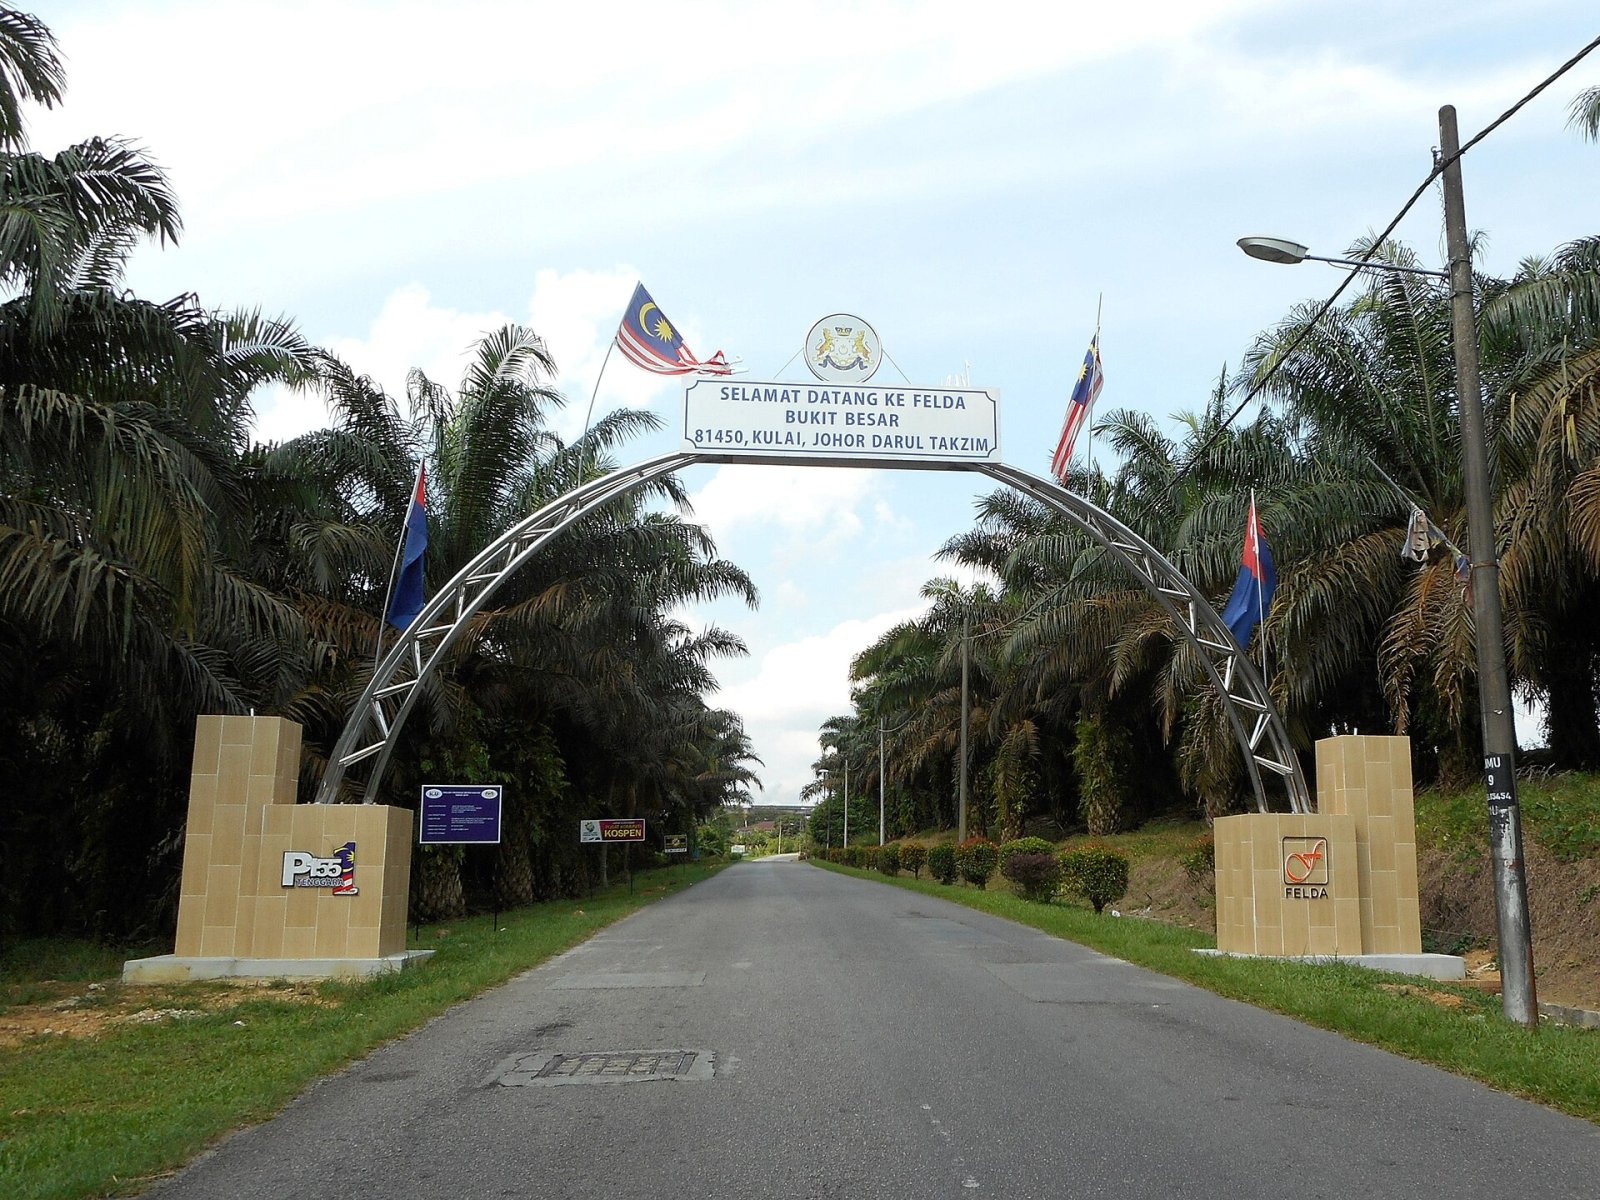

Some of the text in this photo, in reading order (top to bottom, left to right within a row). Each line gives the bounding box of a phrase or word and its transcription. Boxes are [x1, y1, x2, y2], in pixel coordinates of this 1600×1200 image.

[720, 387, 966, 410] SELAMAT DATANG KE FELDA
[785, 410, 899, 427] BUKIT BESAR
[694, 429, 988, 451] 81450, KULAI, JOHOR DARUL TAKZIM
[1488, 774, 1494, 785] 9
[604, 829, 642, 838] KOSPEN
[1285, 887, 1328, 899] FELDA
